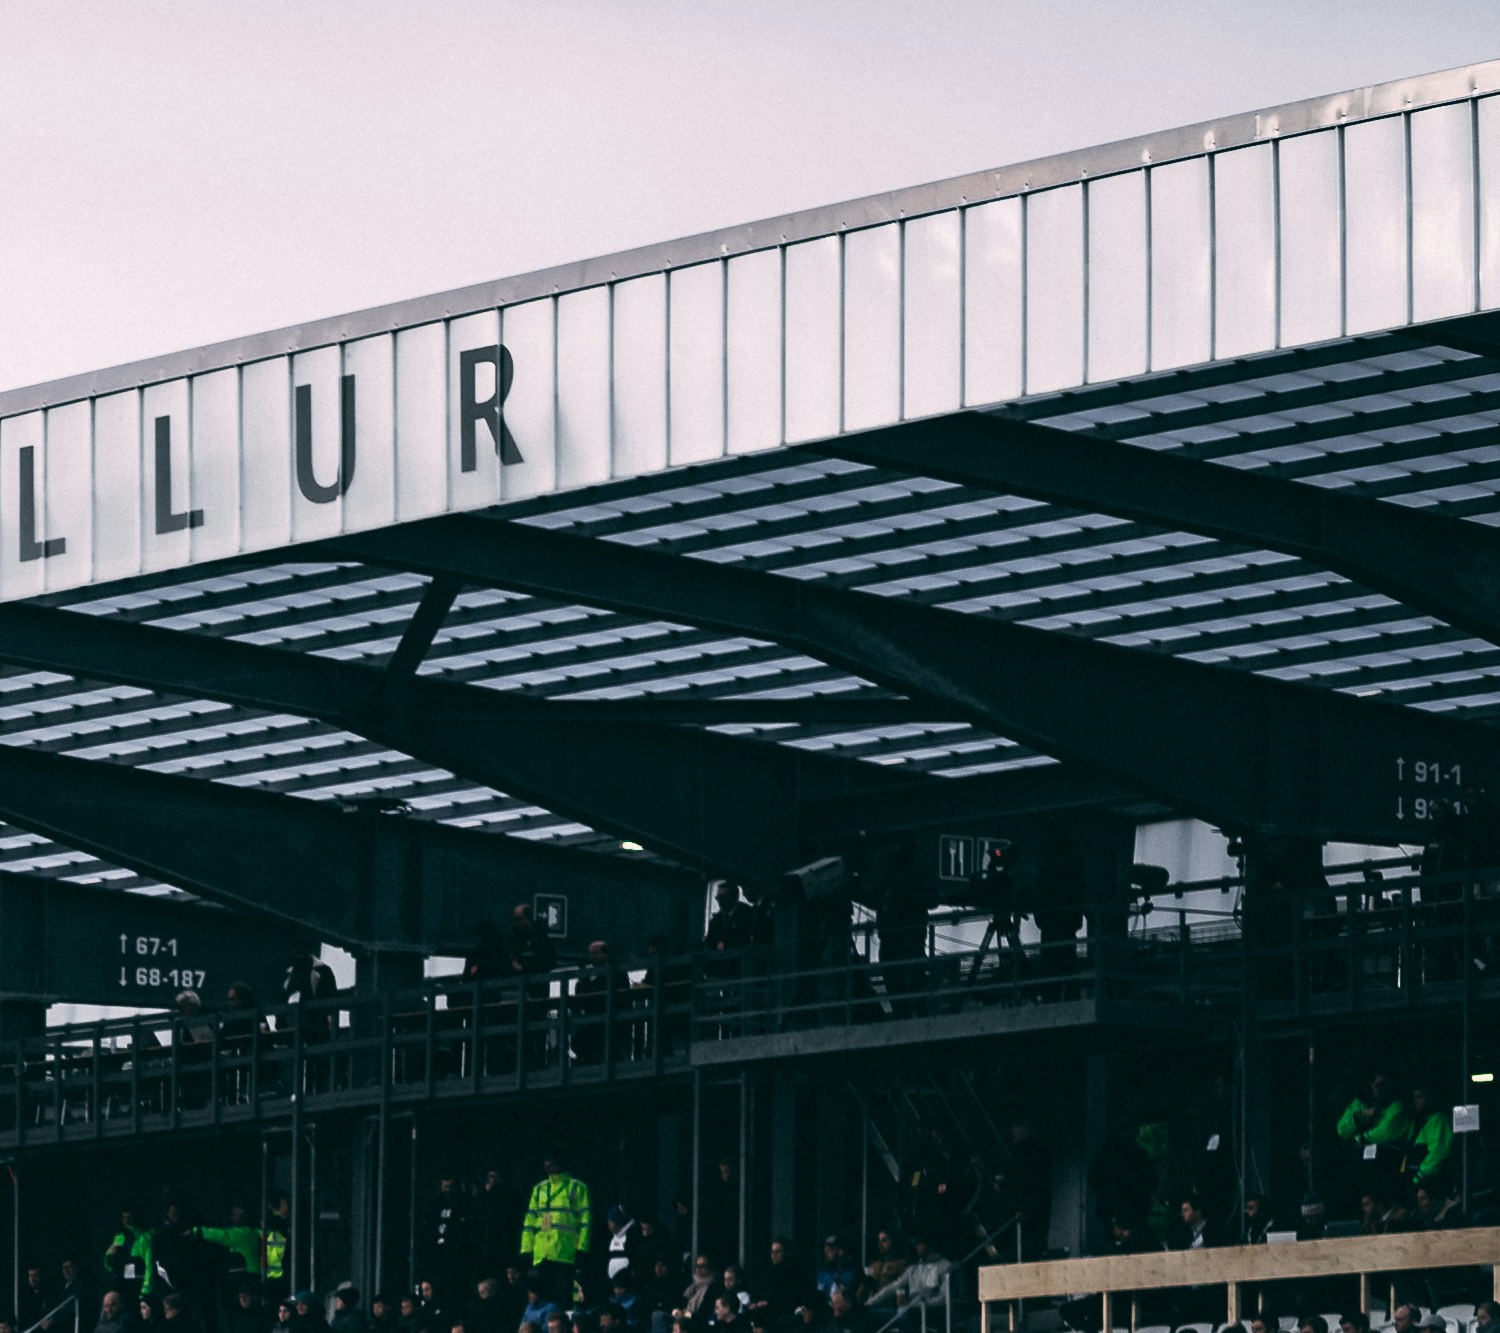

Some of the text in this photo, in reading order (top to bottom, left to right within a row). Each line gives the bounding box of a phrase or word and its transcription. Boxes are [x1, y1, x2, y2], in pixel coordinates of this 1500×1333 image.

[1414, 761, 1461, 786] 91-1
[135, 936, 178, 957] 67-1
[135, 966, 207, 989] 68-187
